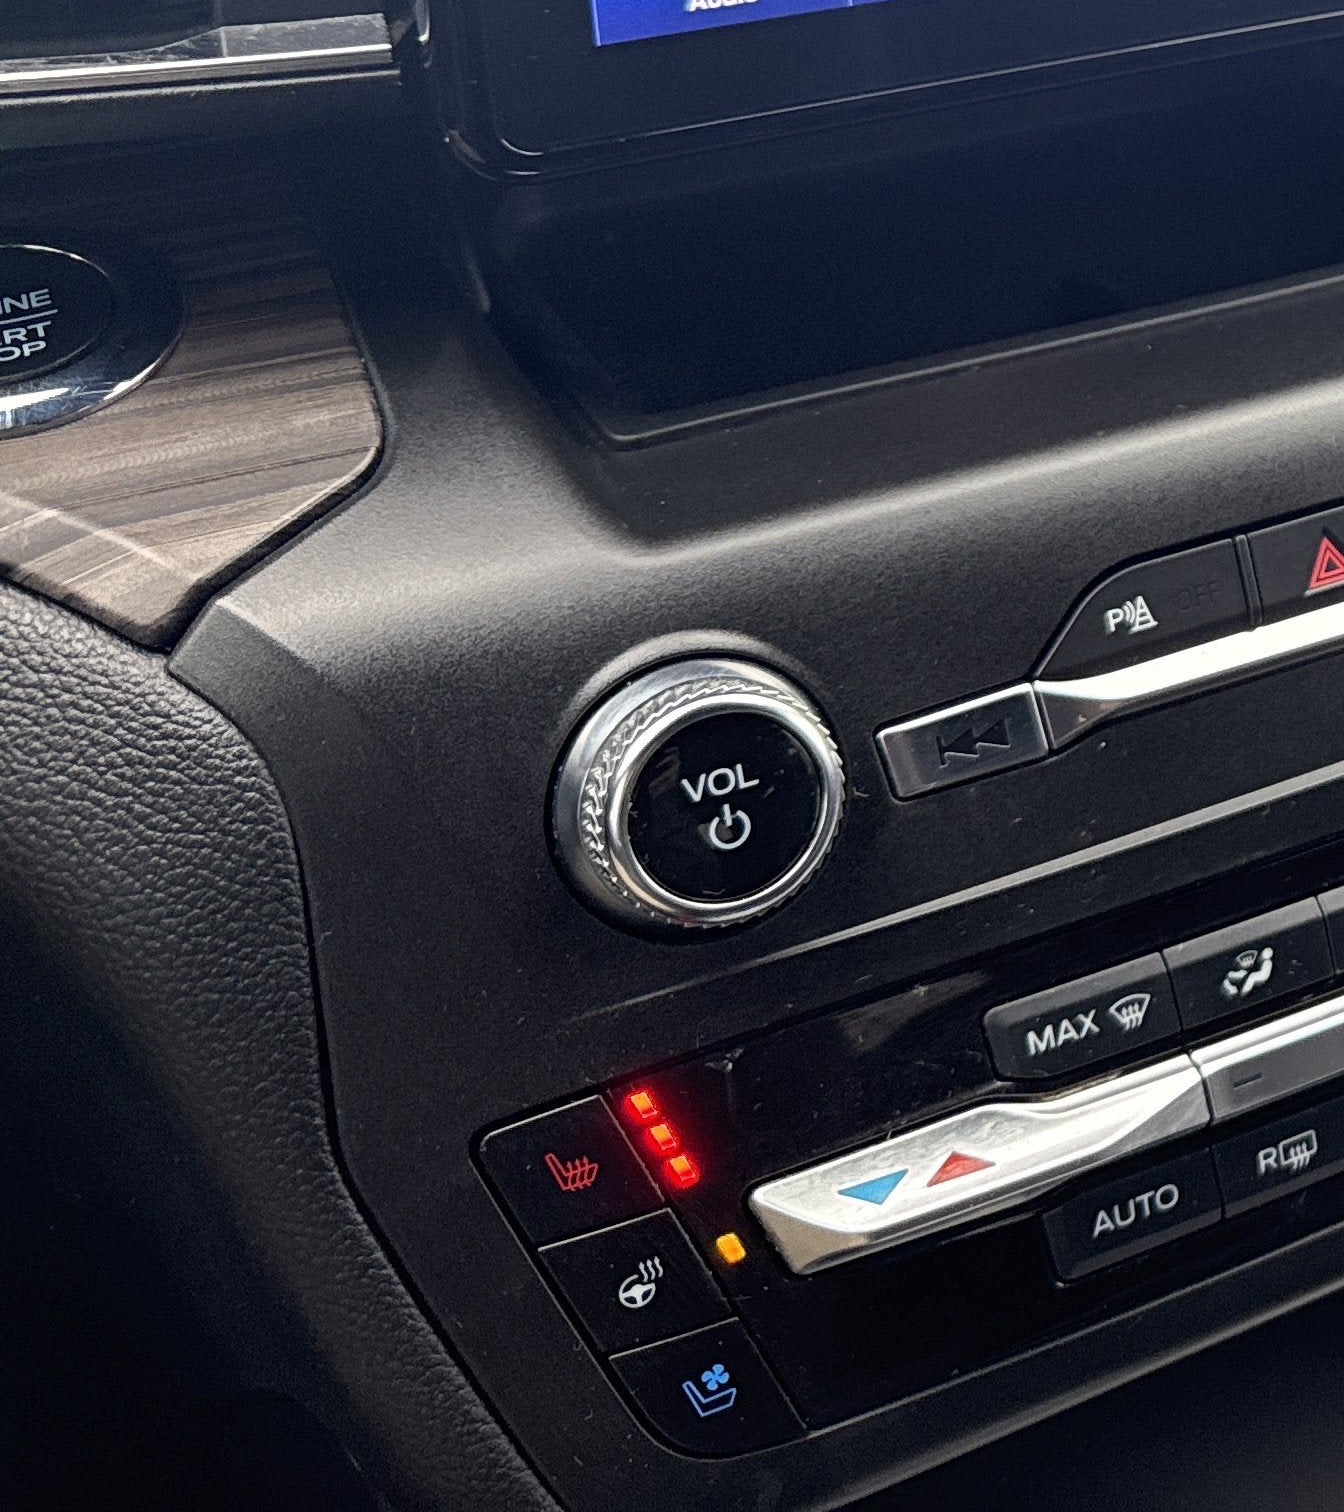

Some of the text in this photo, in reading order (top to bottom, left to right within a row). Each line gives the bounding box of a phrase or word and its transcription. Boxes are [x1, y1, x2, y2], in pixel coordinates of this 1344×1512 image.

[681, 763, 759, 802] VOL
[1026, 1008, 1100, 1057] MAX
[1092, 1184, 1179, 1239] AUTO
